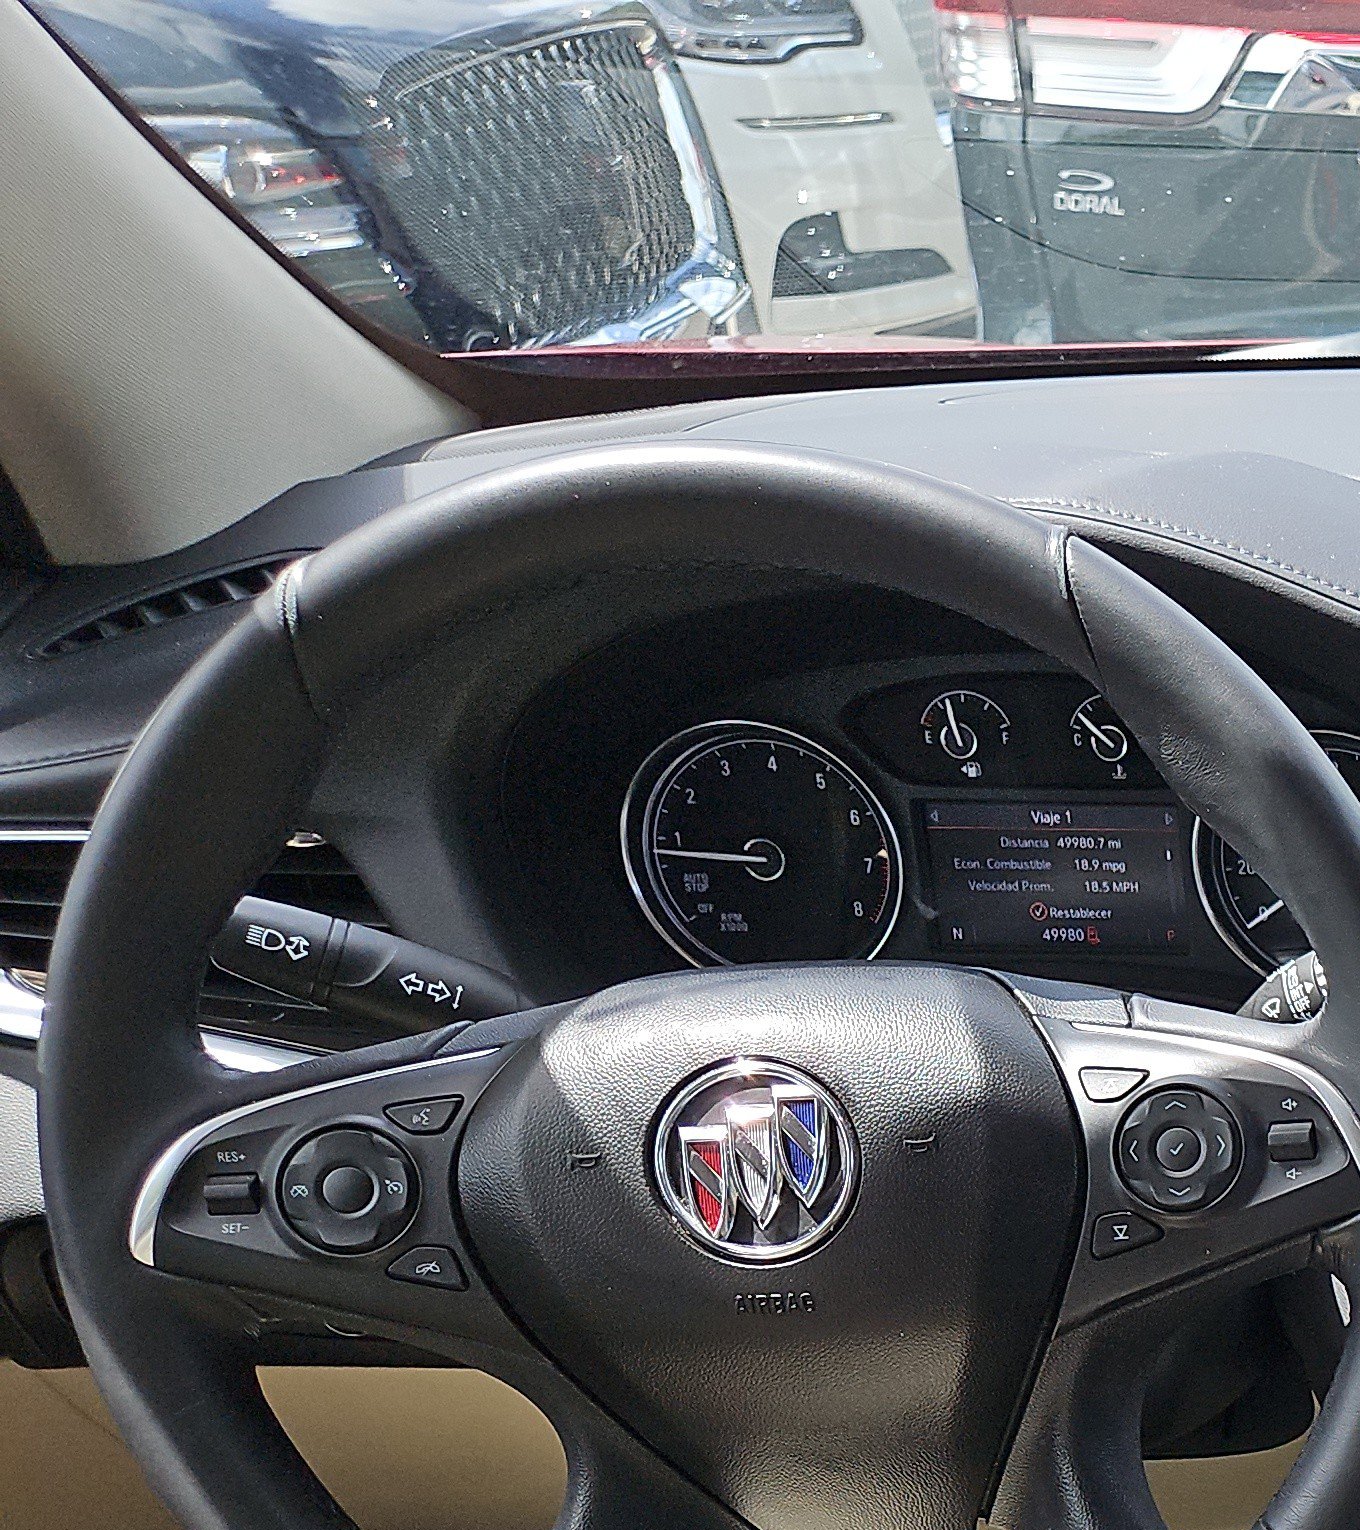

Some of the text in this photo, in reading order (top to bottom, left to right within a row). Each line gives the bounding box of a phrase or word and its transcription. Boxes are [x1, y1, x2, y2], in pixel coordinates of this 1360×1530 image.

[1053, 190, 1126, 216] DORAL
[924, 730, 933, 745] E
[1002, 731, 1010, 745] F
[1073, 733, 1083, 747] C
[721, 760, 730, 776] 3
[767, 756, 778, 772] 4
[816, 774, 826, 790] 5
[685, 788, 697, 805] 2
[850, 809, 860, 826] 6
[1030, 810, 1072, 826] Viaje 1
[674, 832, 681, 846] 1
[1000, 836, 1122, 849] Distancia 49980.7 mi
[864, 858, 873, 874] 7
[954, 858, 1126, 873] Econ. Combustible 18.9 mpg
[968, 880, 1019, 892] Velocidad
[1084, 880, 1110, 893] 18.5
[1112, 882, 1139, 893] MPH
[854, 902, 863, 917] 8
[1050, 907, 1112, 919] Restablecer
[953, 927, 963, 940] N
[1042, 928, 1084, 942] 49980
